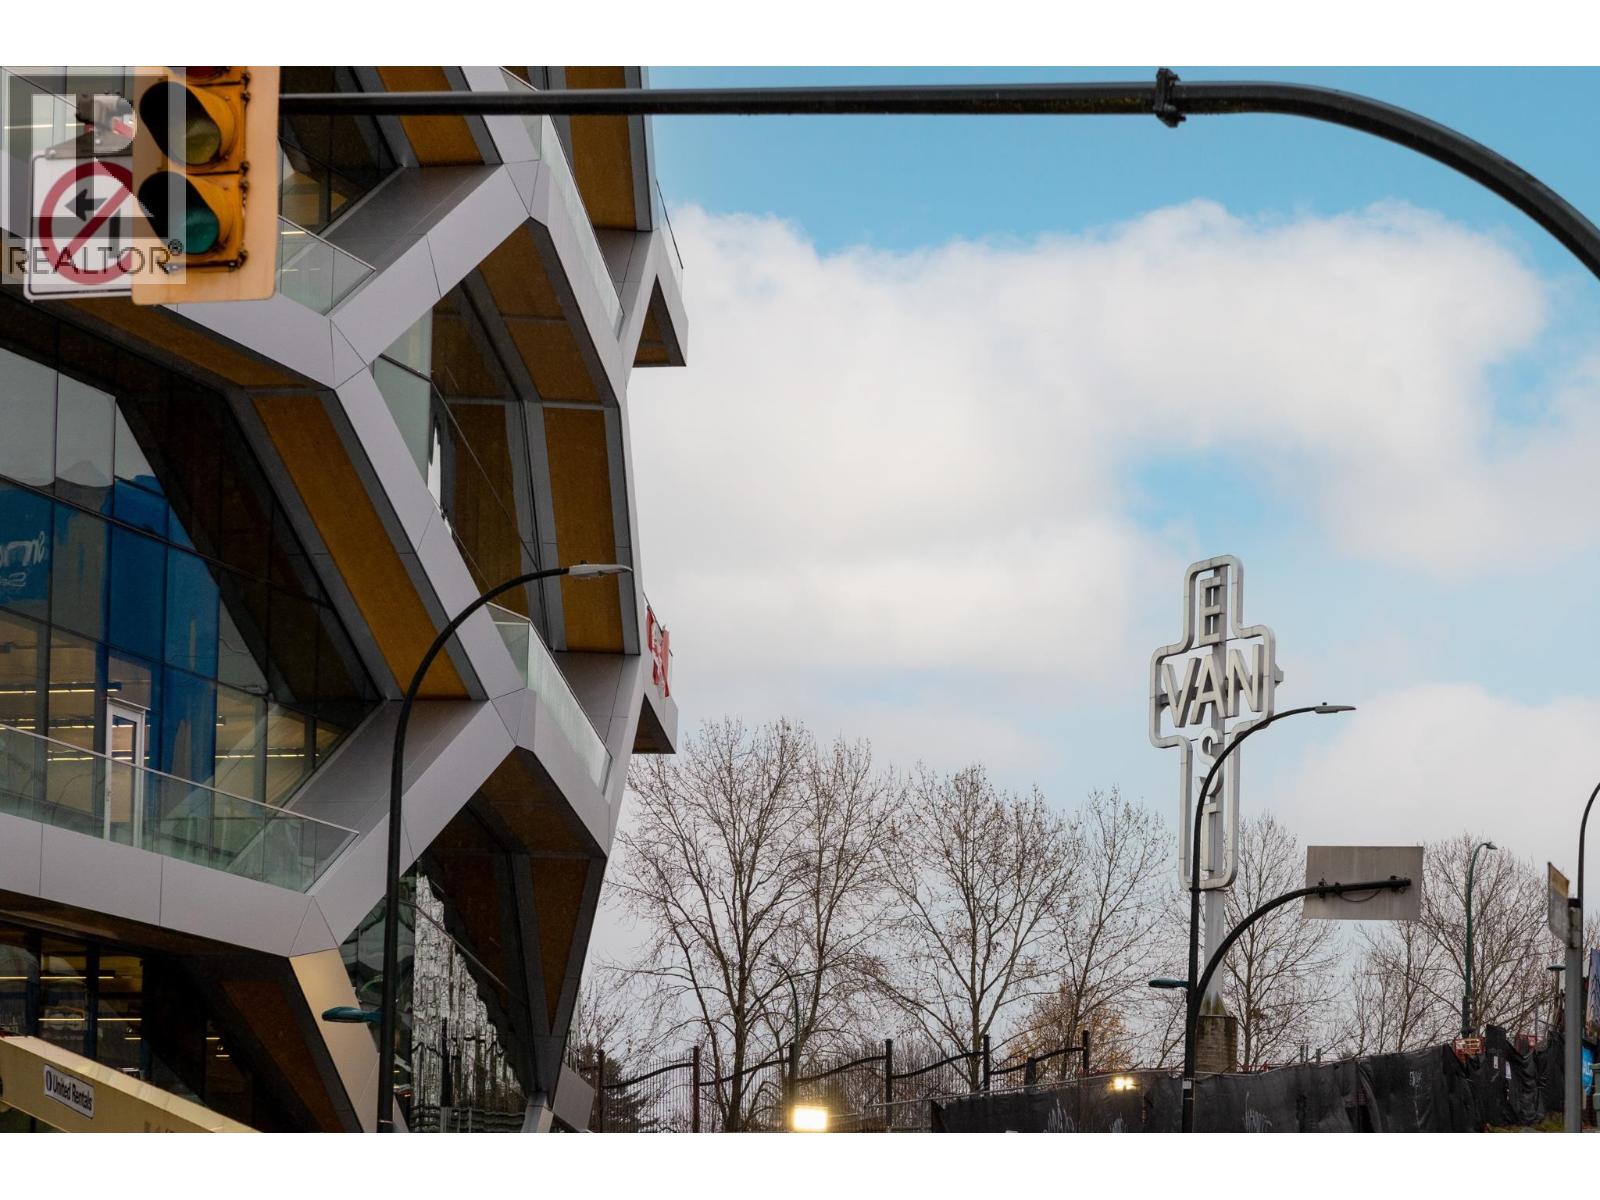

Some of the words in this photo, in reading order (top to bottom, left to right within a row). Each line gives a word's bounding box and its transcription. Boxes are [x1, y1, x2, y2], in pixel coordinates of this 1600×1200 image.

[1161, 644, 1264, 728] VAN
[52, 1073, 71, 1100] United
[71, 1083, 93, 1111] Rentals
